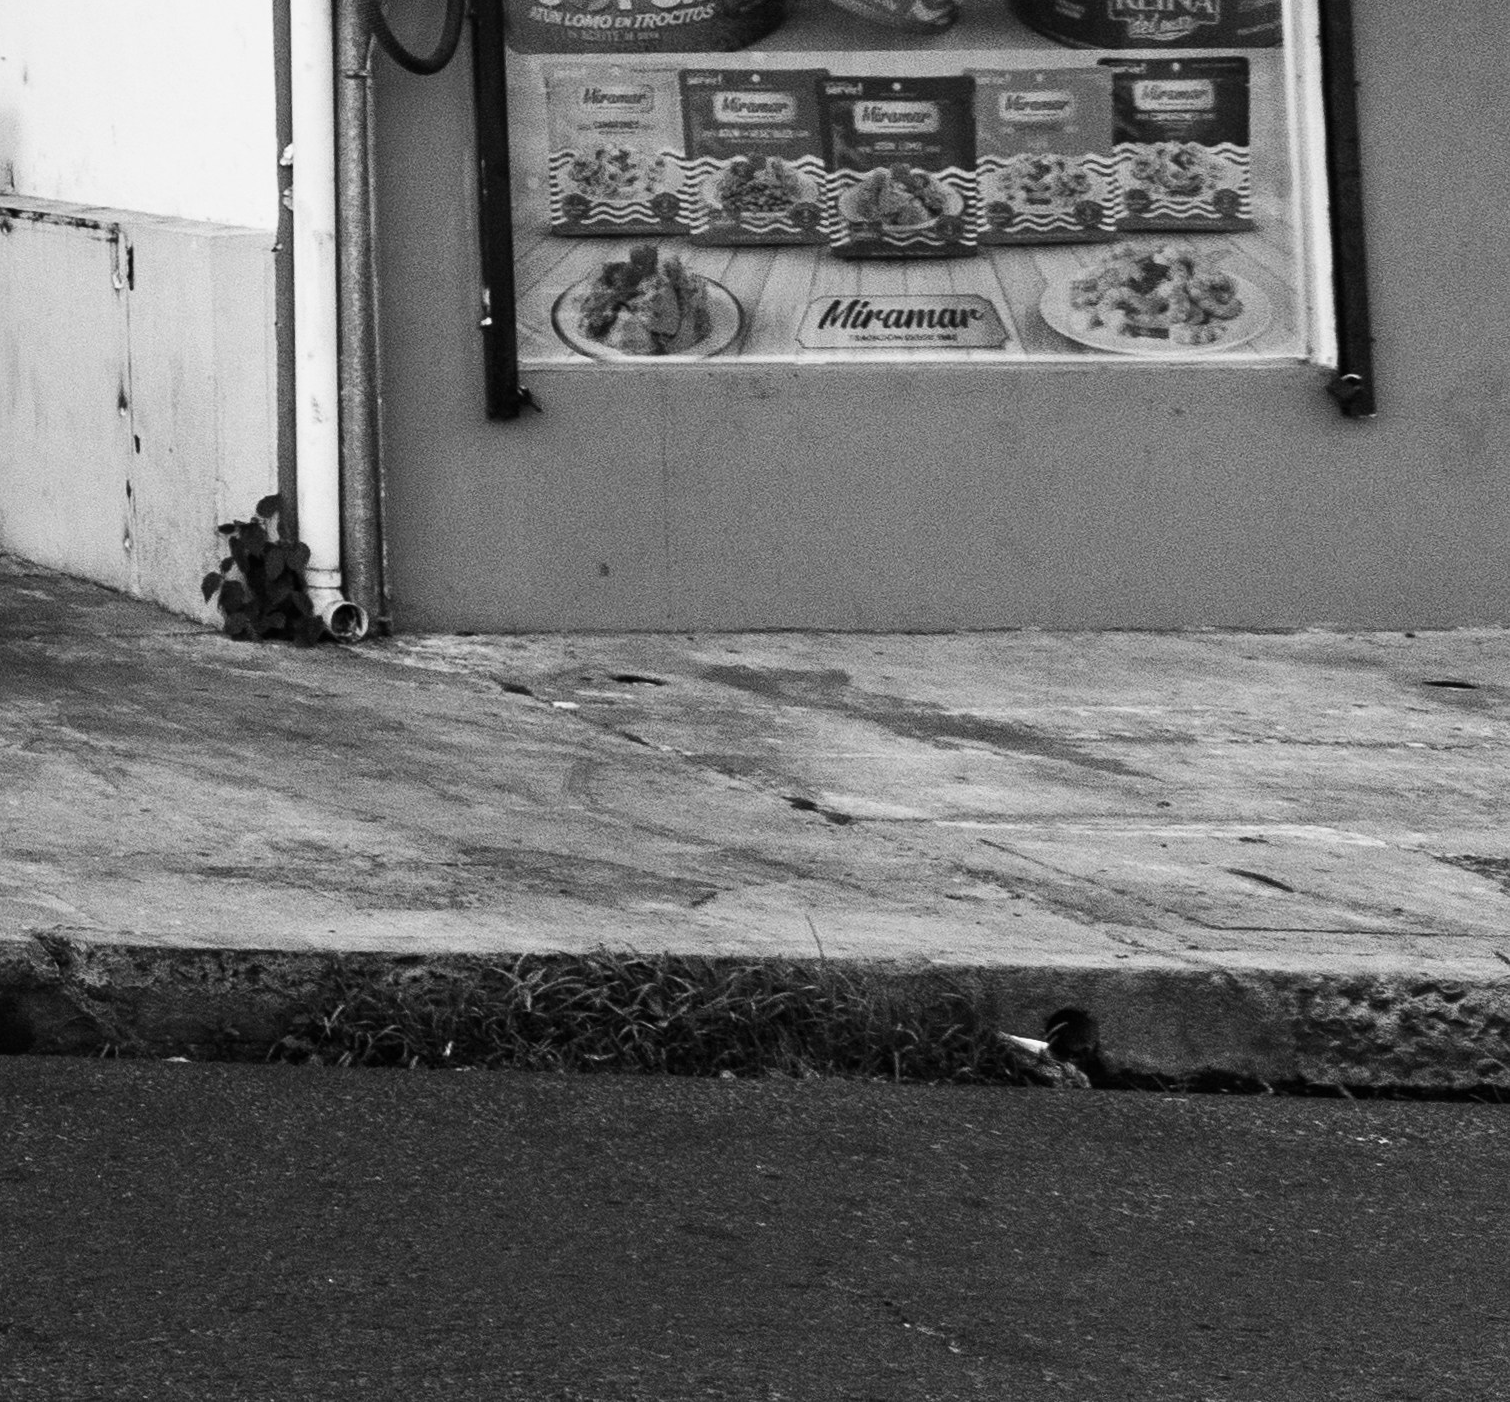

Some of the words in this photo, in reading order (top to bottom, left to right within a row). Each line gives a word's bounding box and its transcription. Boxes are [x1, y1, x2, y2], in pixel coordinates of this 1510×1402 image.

[563, 13, 613, 28] LOMO
[633, 3, 716, 28] TROCITOS
[817, 299, 985, 329] Miramar
